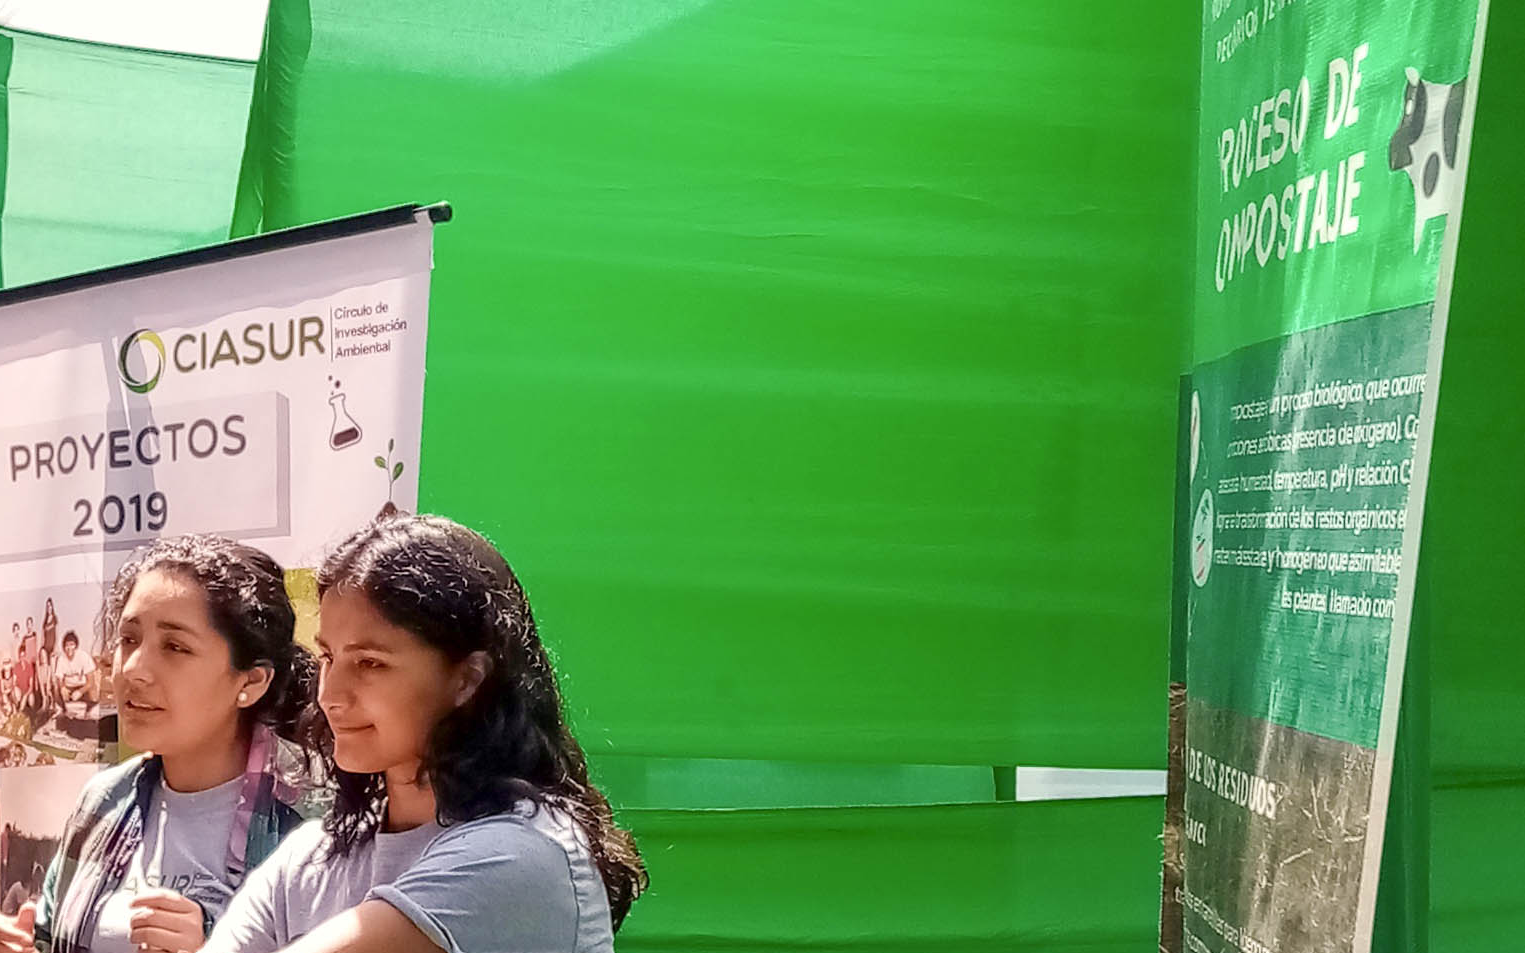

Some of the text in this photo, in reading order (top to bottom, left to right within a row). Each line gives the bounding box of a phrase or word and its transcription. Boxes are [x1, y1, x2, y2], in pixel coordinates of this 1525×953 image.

[1324, 42, 1369, 140] DE
[375, 301, 389, 314] de
[174, 315, 325, 373] CIASUR
[335, 318, 407, 339] Investigación
[336, 339, 391, 358] Ambiental
[10, 414, 247, 482] PROYECTOS
[73, 491, 168, 536] 2019
[1345, 504, 1396, 535] orgánicos
